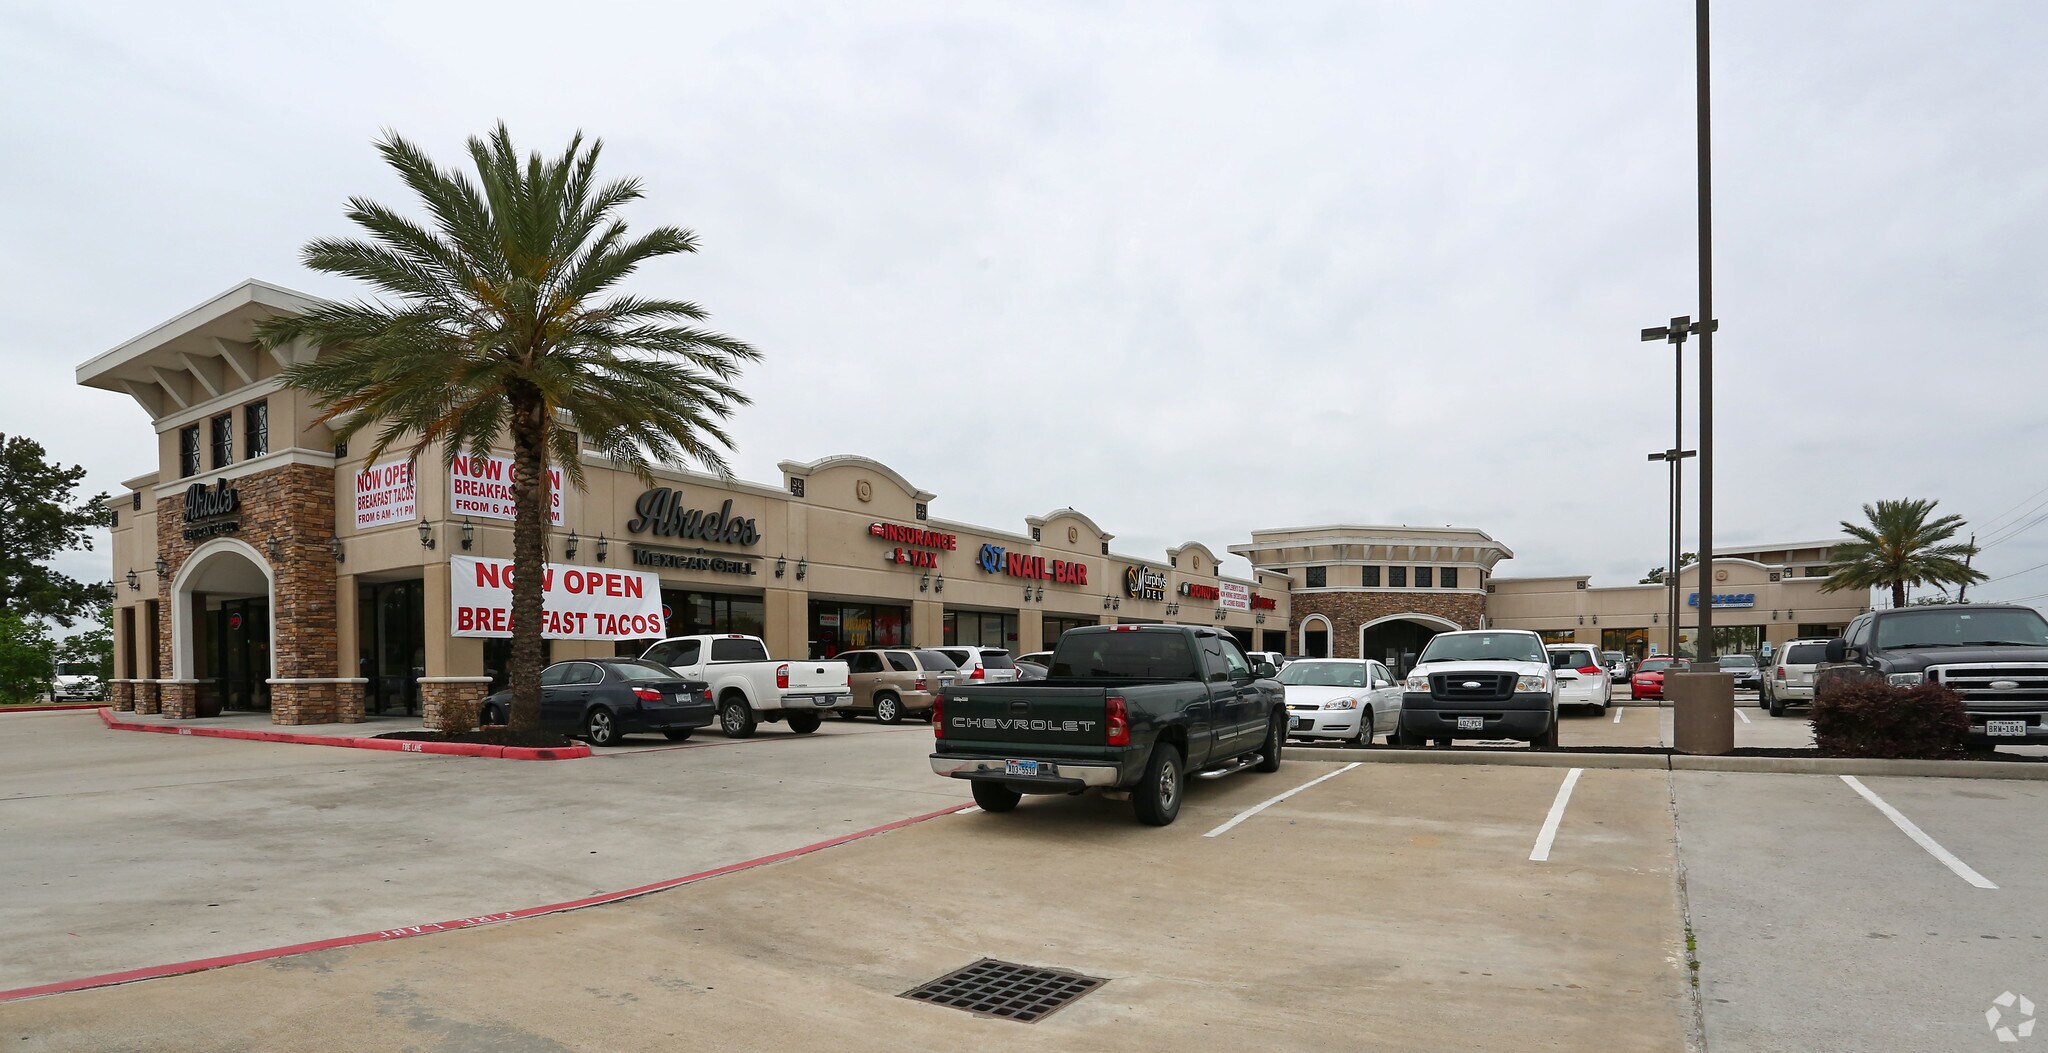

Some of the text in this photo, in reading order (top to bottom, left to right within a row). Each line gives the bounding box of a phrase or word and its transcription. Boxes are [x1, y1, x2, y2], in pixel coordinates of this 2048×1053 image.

[454, 456, 502, 480] NOW
[357, 470, 382, 494] NOW
[358, 484, 414, 510] BREAKFAST TACOS
[456, 500, 488, 514] FROM
[493, 504, 498, 513] 6
[358, 512, 375, 524] FROM
[376, 512, 380, 520] 6
[381, 510, 391, 520] AM
[396, 508, 403, 517] 11
[404, 505, 414, 516] PM
[628, 487, 761, 546] Abuelos
[882, 522, 956, 551] INSURANCE
[894, 547, 937, 568] & TAX
[1006, 552, 1052, 580] NAIL
[1053, 560, 1088, 585] BAR
[564, 570, 643, 598] OPEN
[1190, 583, 1219, 600] DONUTS
[594, 613, 661, 635] TACOS
[952, 717, 1096, 732] CHEVROLET
